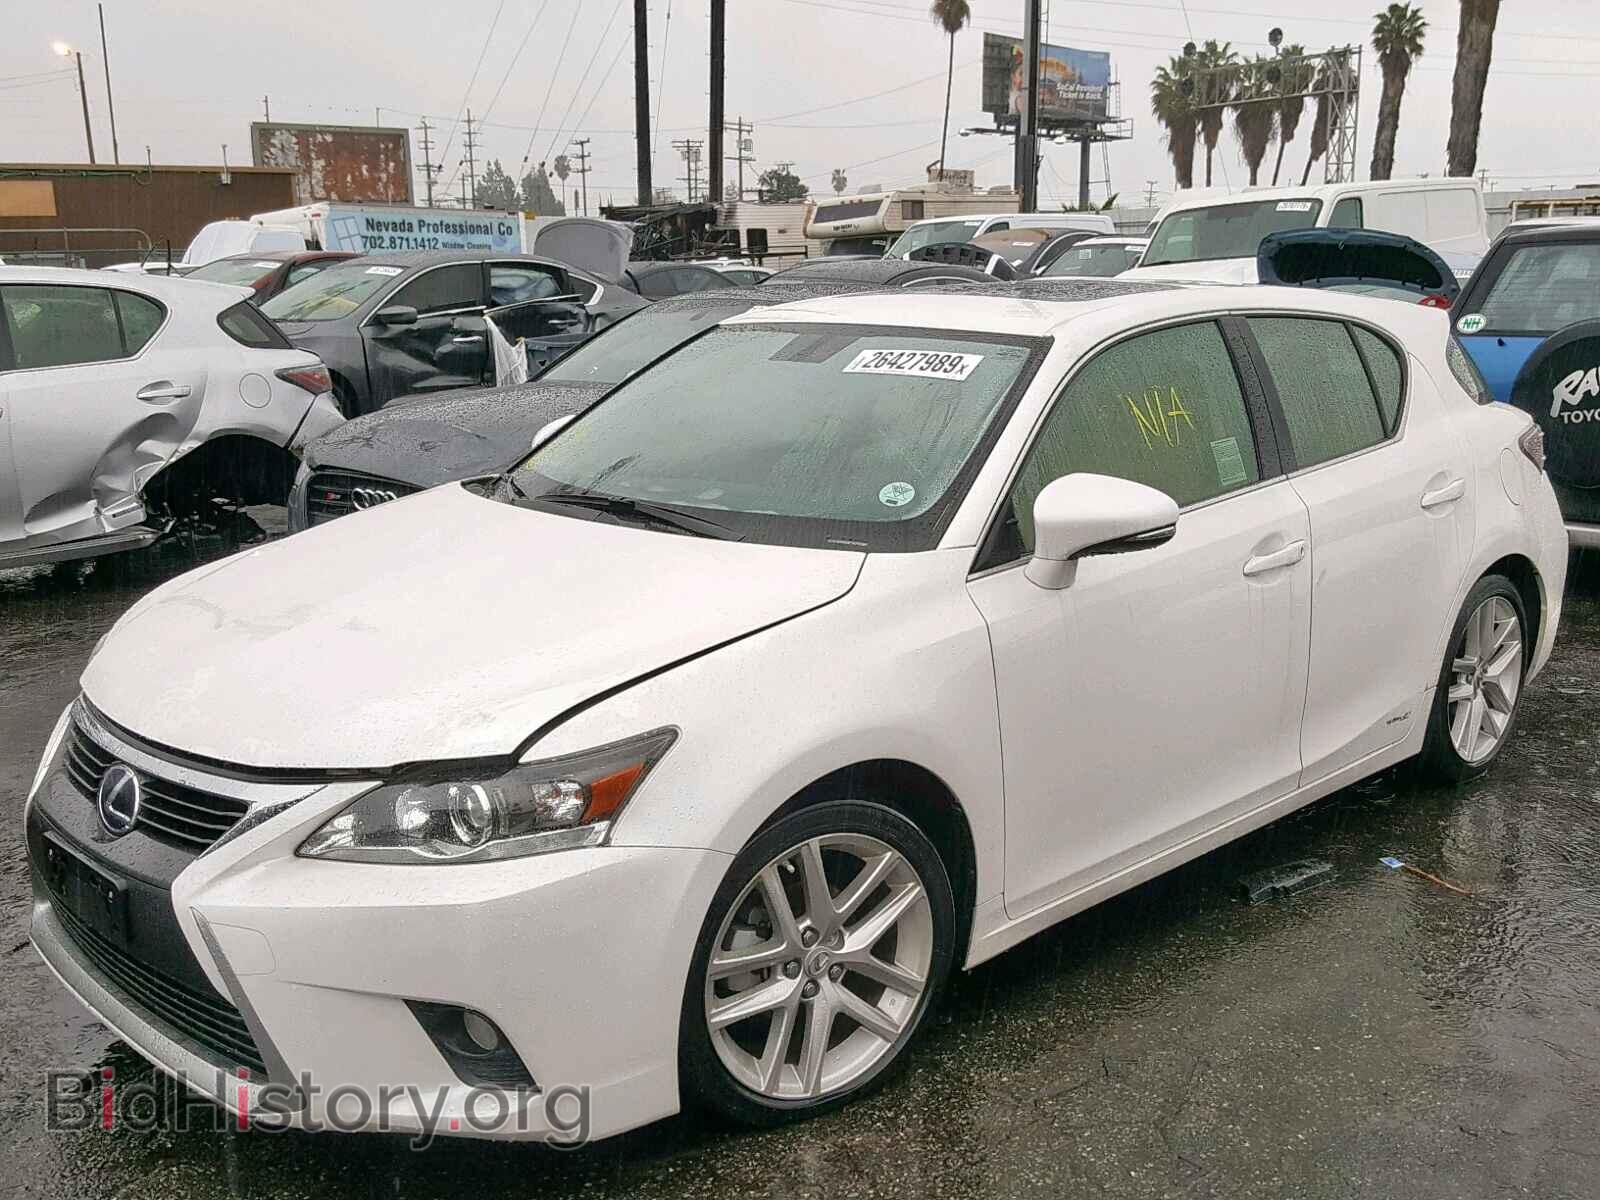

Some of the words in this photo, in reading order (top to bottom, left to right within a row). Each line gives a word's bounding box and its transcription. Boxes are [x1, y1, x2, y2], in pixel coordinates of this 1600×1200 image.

[366, 218, 414, 233] Nevada
[418, 219, 493, 235] Professional
[498, 222, 513, 236] Co
[362, 235, 439, 250] 702.871.1412
[1550, 366, 1600, 418] RA
